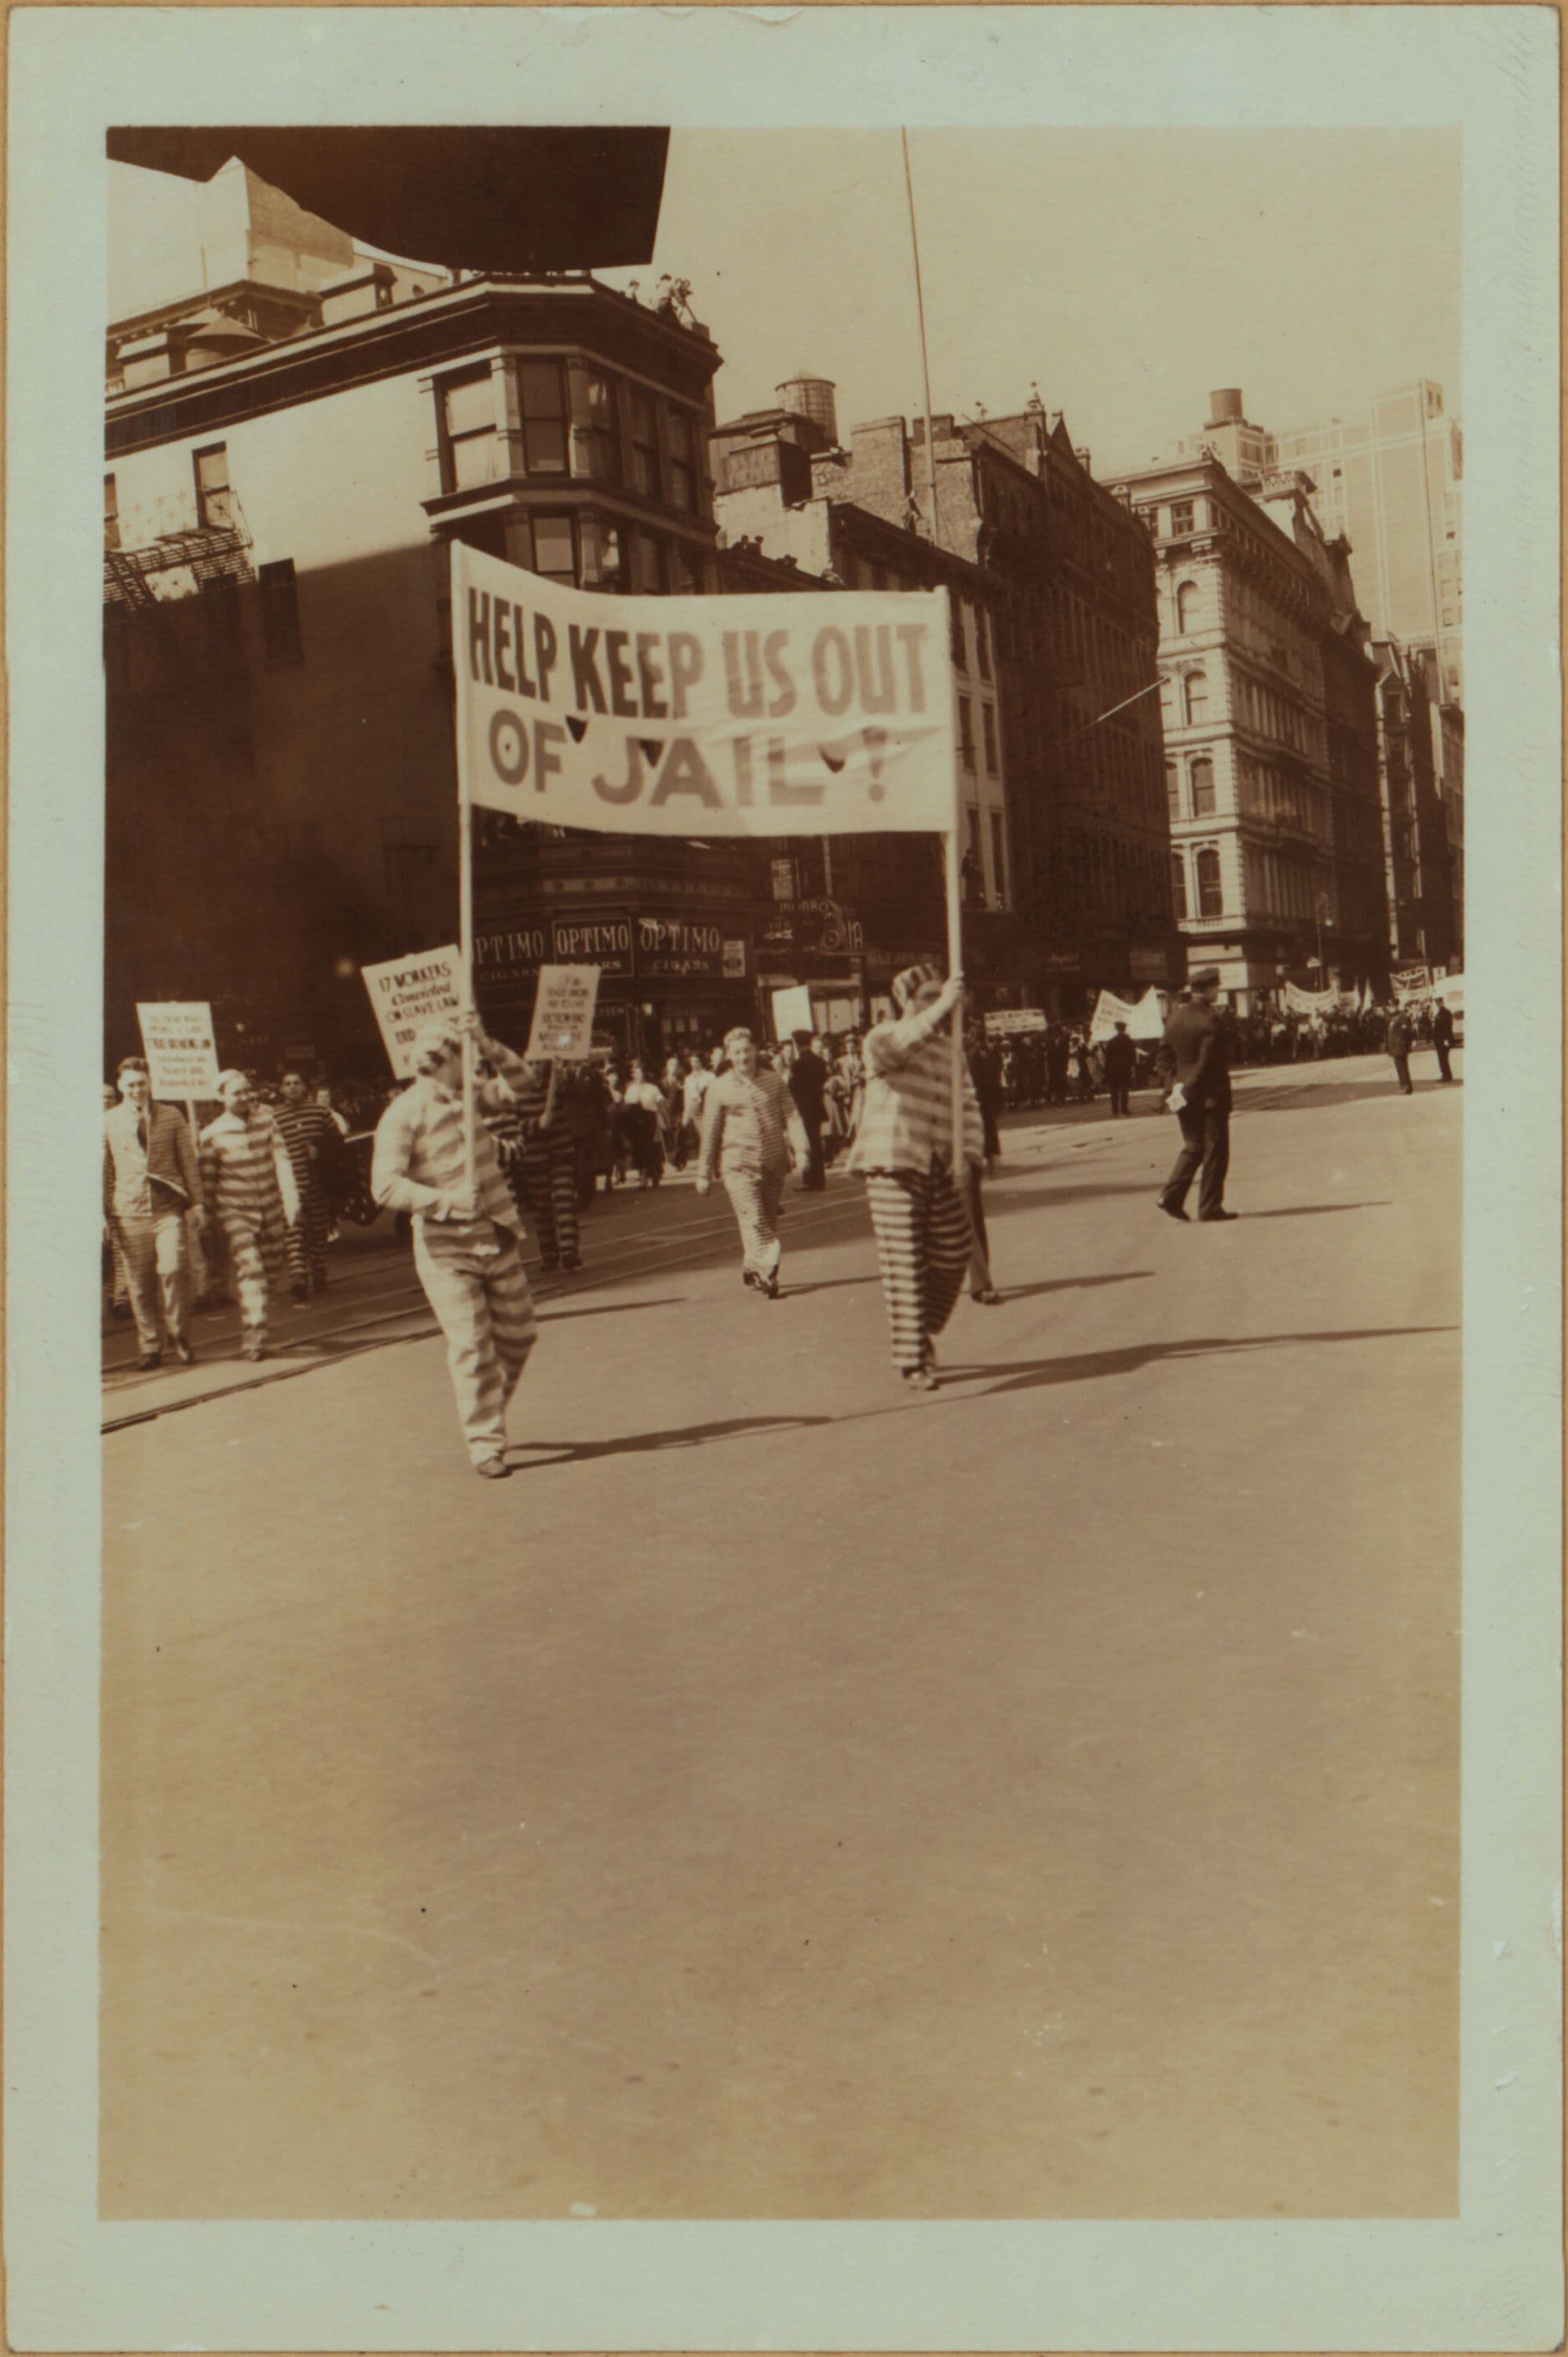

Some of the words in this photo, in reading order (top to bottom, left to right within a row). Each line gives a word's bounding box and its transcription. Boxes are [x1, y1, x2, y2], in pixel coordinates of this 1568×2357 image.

[467, 587, 557, 703] HELP
[567, 624, 705, 720] KEEP
[723, 630, 798, 720] US
[812, 623, 930, 717] OUT
[488, 709, 568, 793] OF
[592, 725, 888, 809] JAIL!
[474, 929, 544, 964] PTIMO
[557, 925, 628, 956] OPTIMO
[640, 924, 720, 953] OPTIMO
[378, 977, 391, 993] 17
[394, 961, 451, 988] WORKERS
[652, 960, 710, 971] CIGARS
[403, 1001, 435, 1019] SLAVE
[437, 993, 459, 1010] LAW
